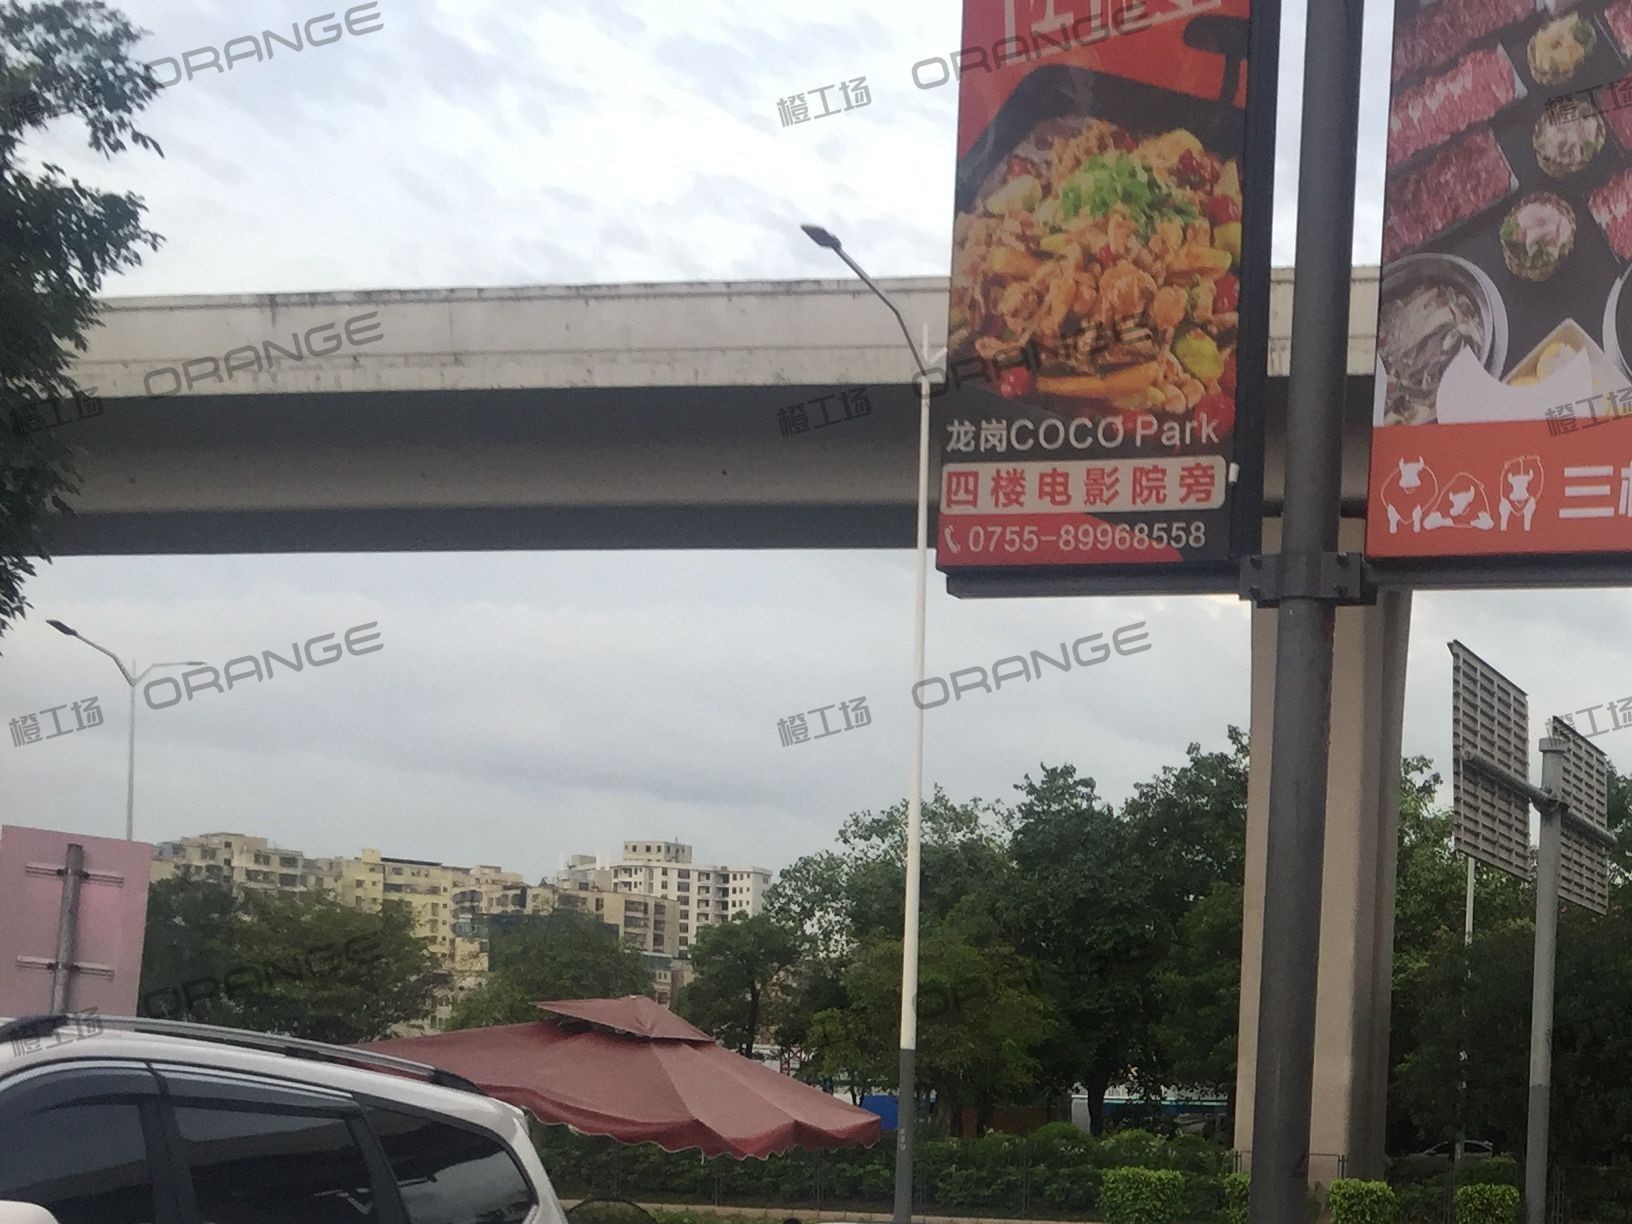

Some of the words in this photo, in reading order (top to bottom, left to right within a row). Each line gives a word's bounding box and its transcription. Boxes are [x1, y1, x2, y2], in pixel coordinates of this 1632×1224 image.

[946, 416, 1125, 452] 龙岗COCO
[1135, 411, 1220, 447] Park
[945, 463, 1217, 509] 四楼电影院旁
[968, 521, 1207, 553] 0755-89968558
